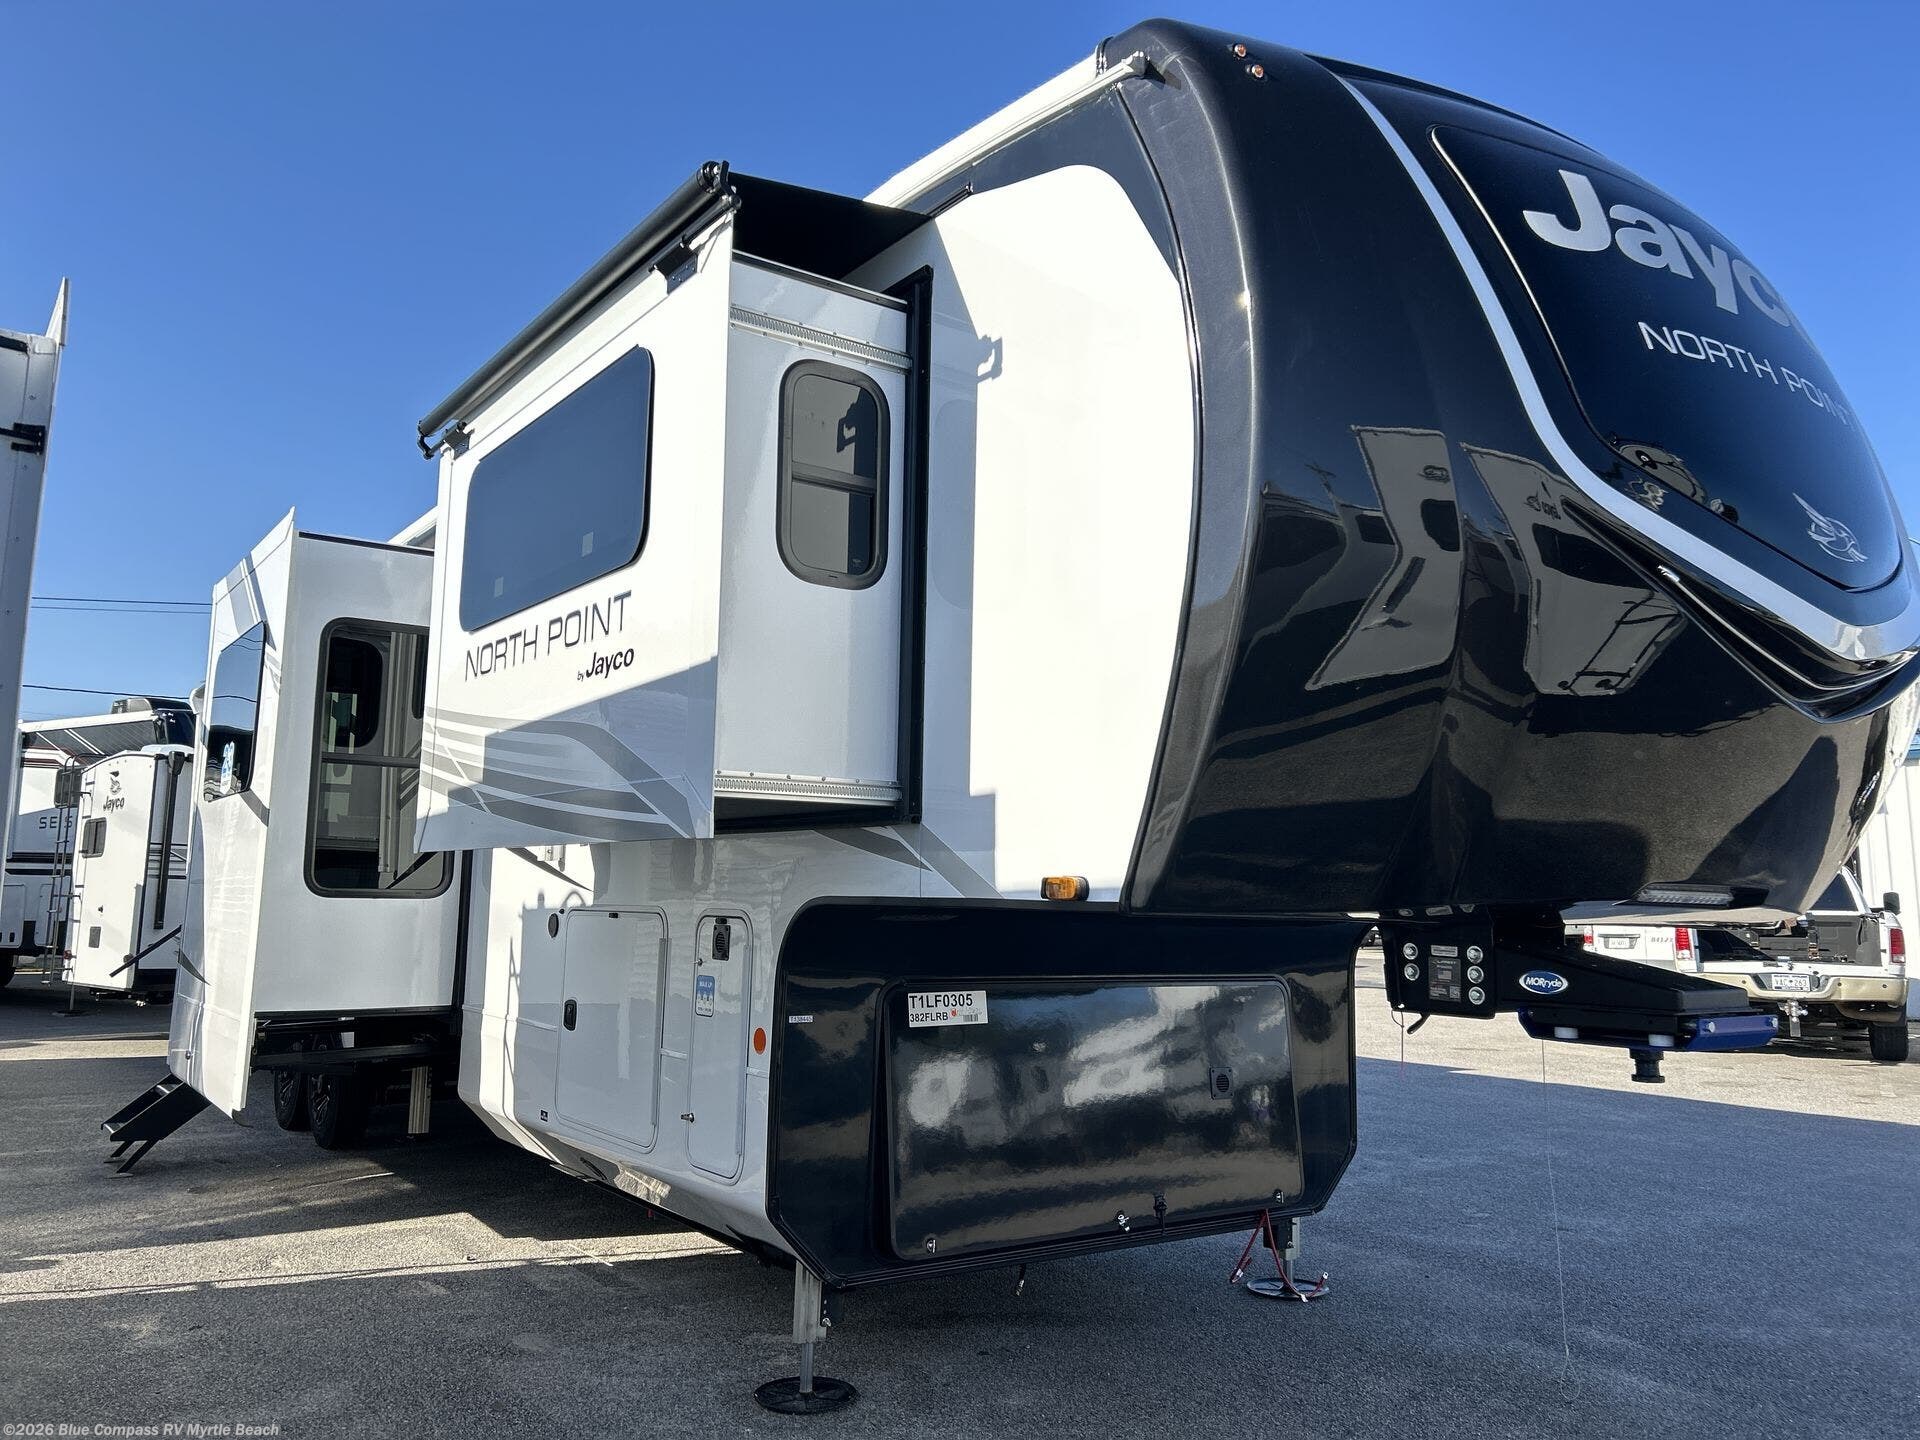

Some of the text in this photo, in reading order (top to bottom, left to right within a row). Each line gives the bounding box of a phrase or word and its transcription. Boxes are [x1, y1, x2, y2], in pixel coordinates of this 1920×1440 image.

[1523, 169, 1808, 340] Jayc
[1638, 322, 1778, 385] NORTH
[465, 590, 632, 682] NORTH POINT
[577, 648, 634, 682] by Jayco
[103, 796, 125, 814] Jayco
[909, 994, 973, 1008] T1LF0305
[910, 1012, 949, 1023] 382FLRB
